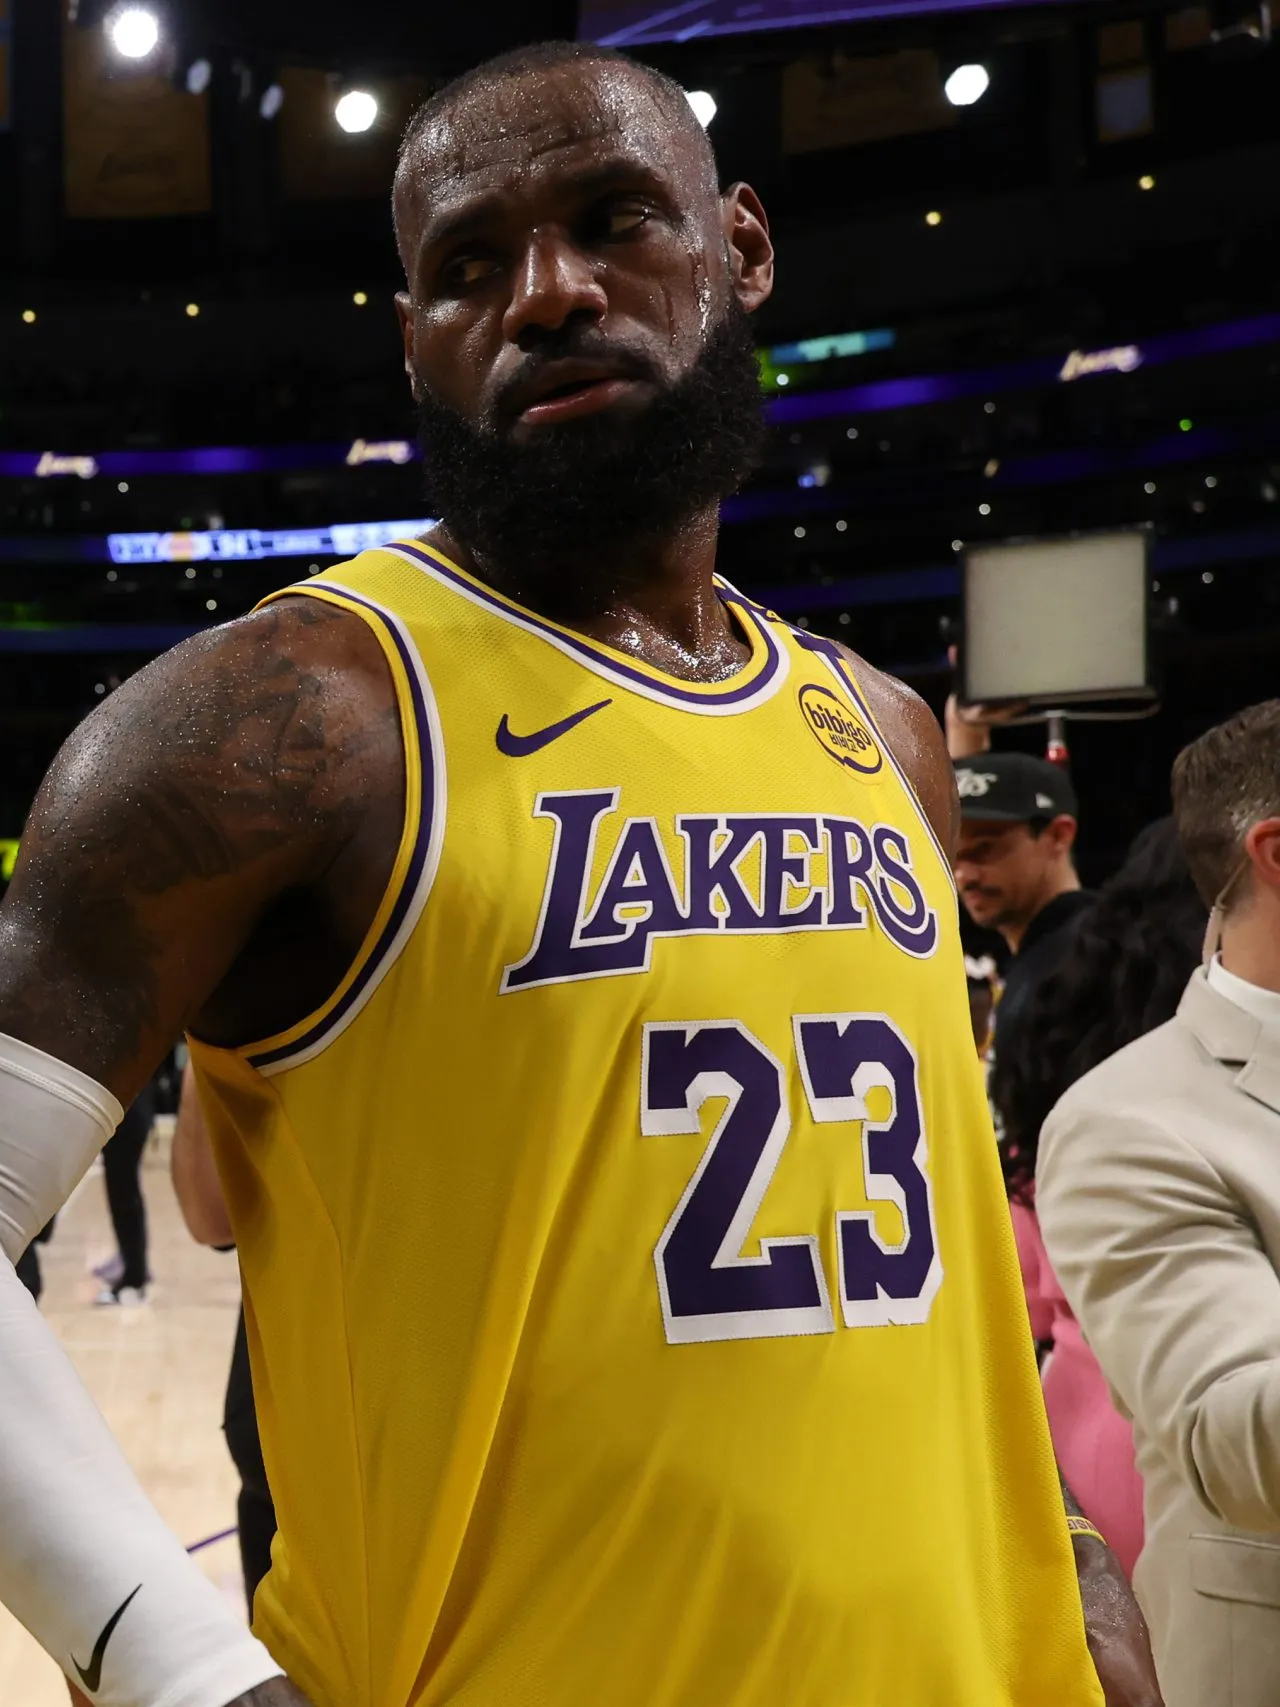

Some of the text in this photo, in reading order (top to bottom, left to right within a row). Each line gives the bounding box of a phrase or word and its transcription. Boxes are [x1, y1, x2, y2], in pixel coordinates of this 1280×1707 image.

[804, 702, 872, 751] bibigo
[498, 786, 939, 996] LAKERS
[640, 1012, 943, 1345] 23
